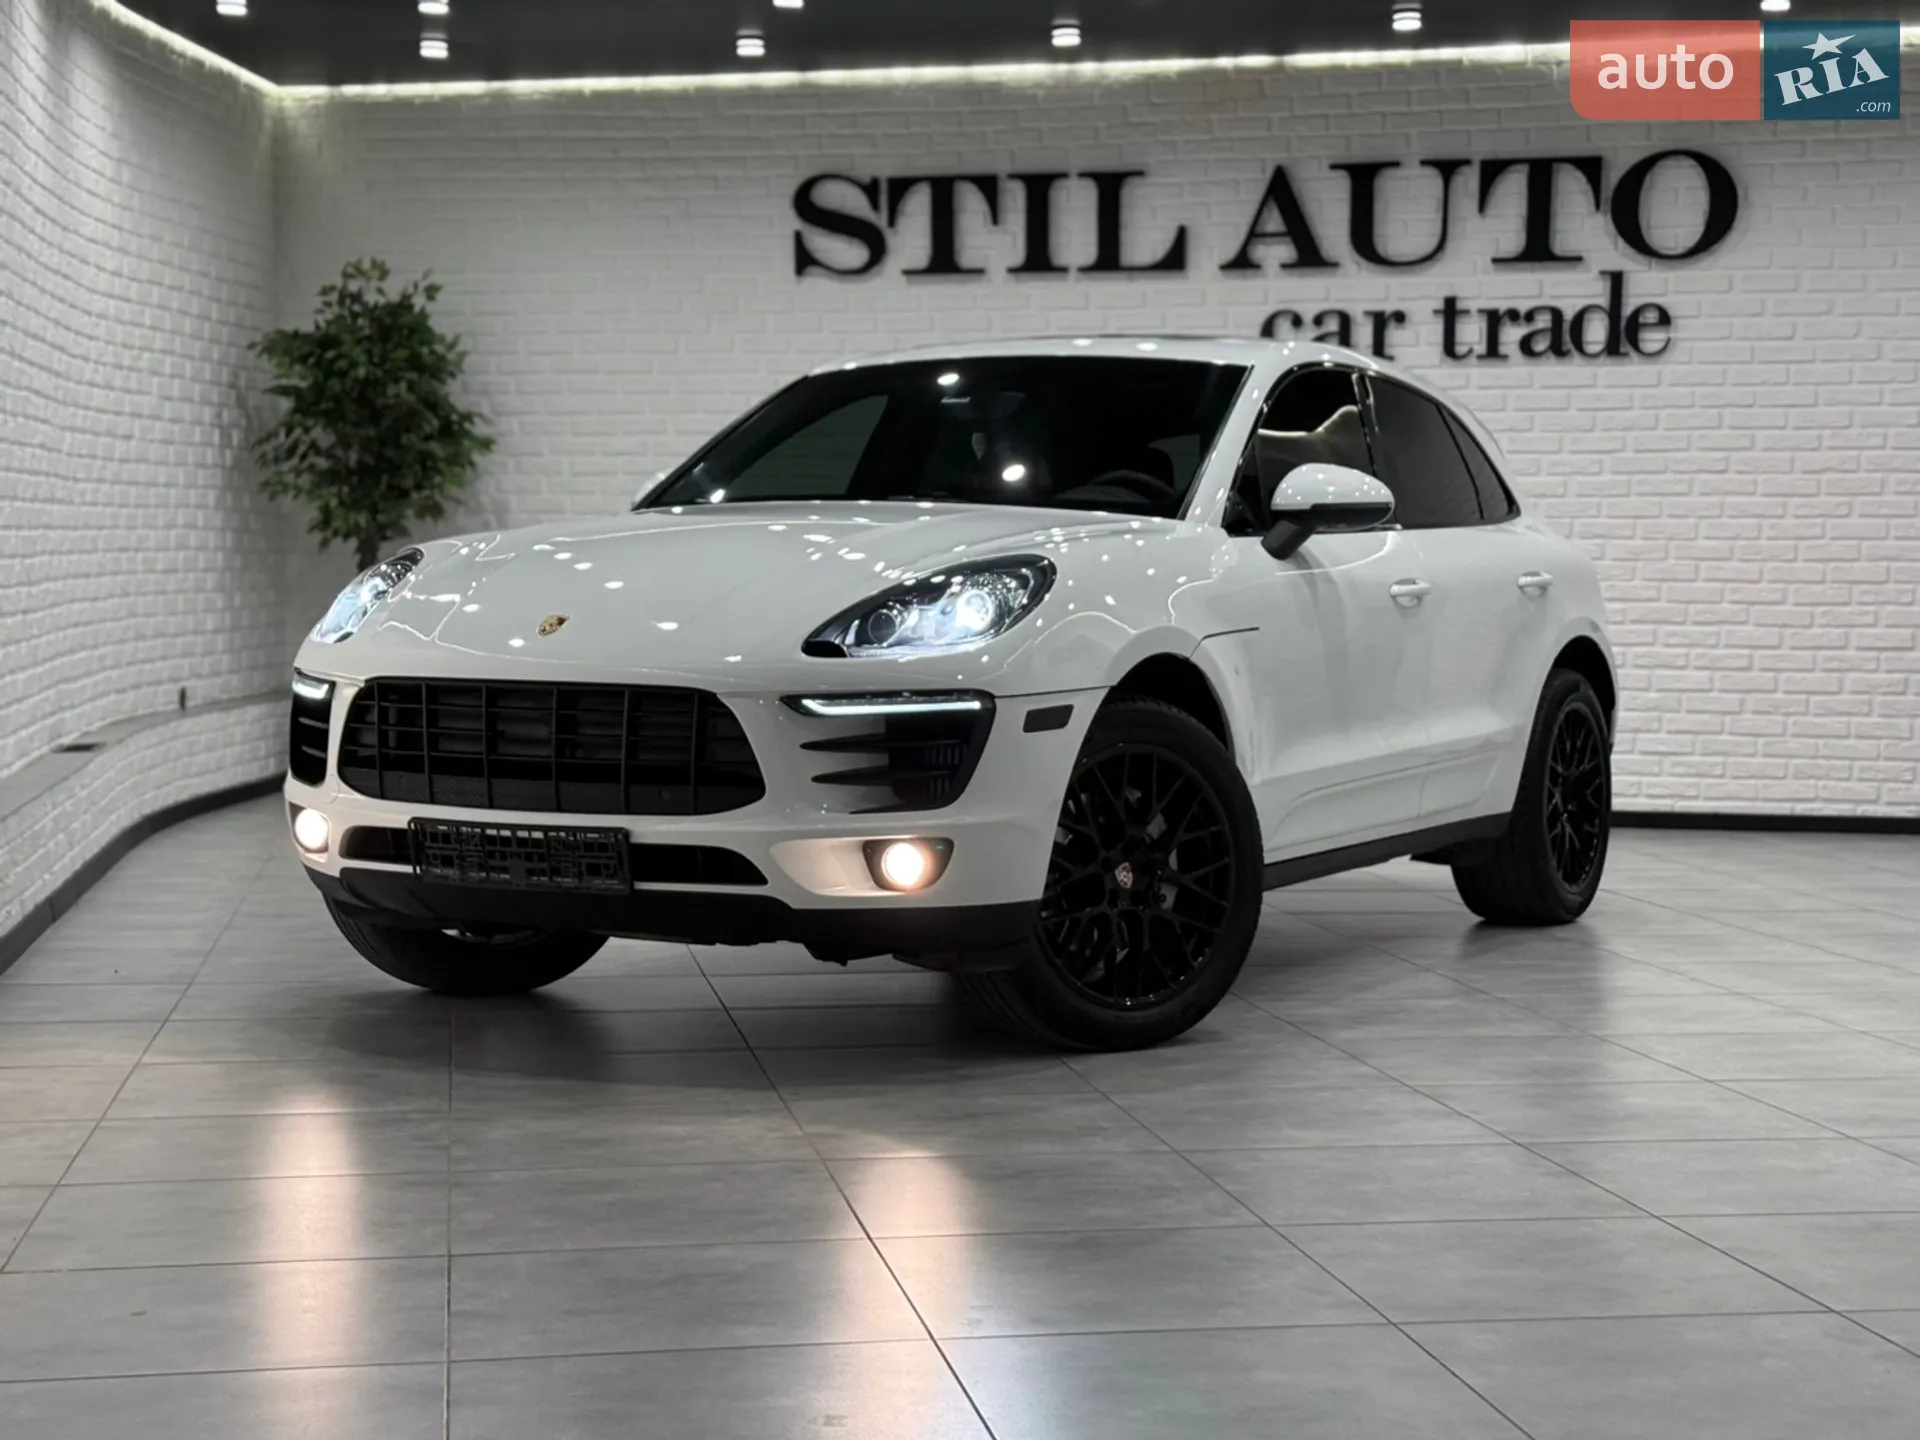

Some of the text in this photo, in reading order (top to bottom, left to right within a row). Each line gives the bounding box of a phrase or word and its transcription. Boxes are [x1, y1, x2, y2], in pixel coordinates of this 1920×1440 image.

[793, 149, 1739, 277] STIL AUTO
[1432, 272, 1673, 360] trade
